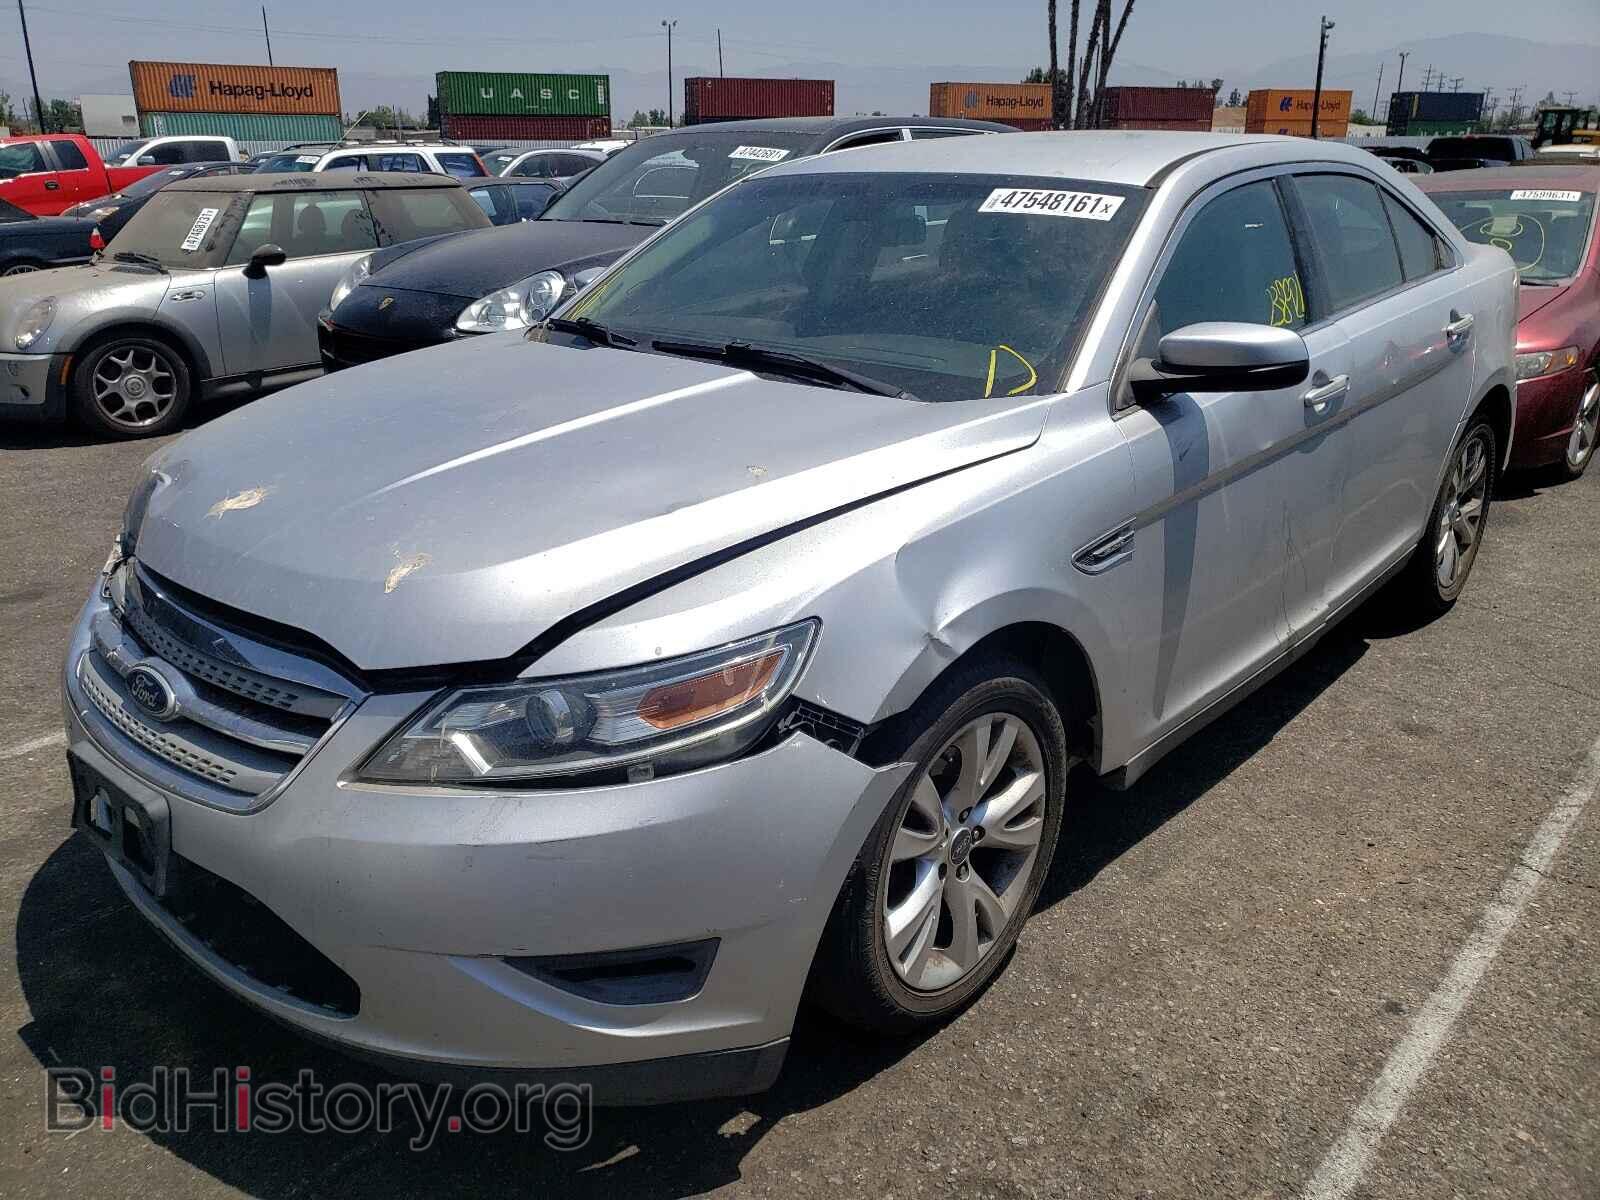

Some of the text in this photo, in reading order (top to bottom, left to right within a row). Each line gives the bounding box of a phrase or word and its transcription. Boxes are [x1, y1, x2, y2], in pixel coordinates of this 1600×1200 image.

[209, 80, 314, 100] Hapag-Lloyd
[985, 95, 1044, 110] Hapag-Lloyd
[1000, 190, 1104, 213] 47548161
[984, 344, 1039, 399] D
[131, 674, 160, 707] Ford
